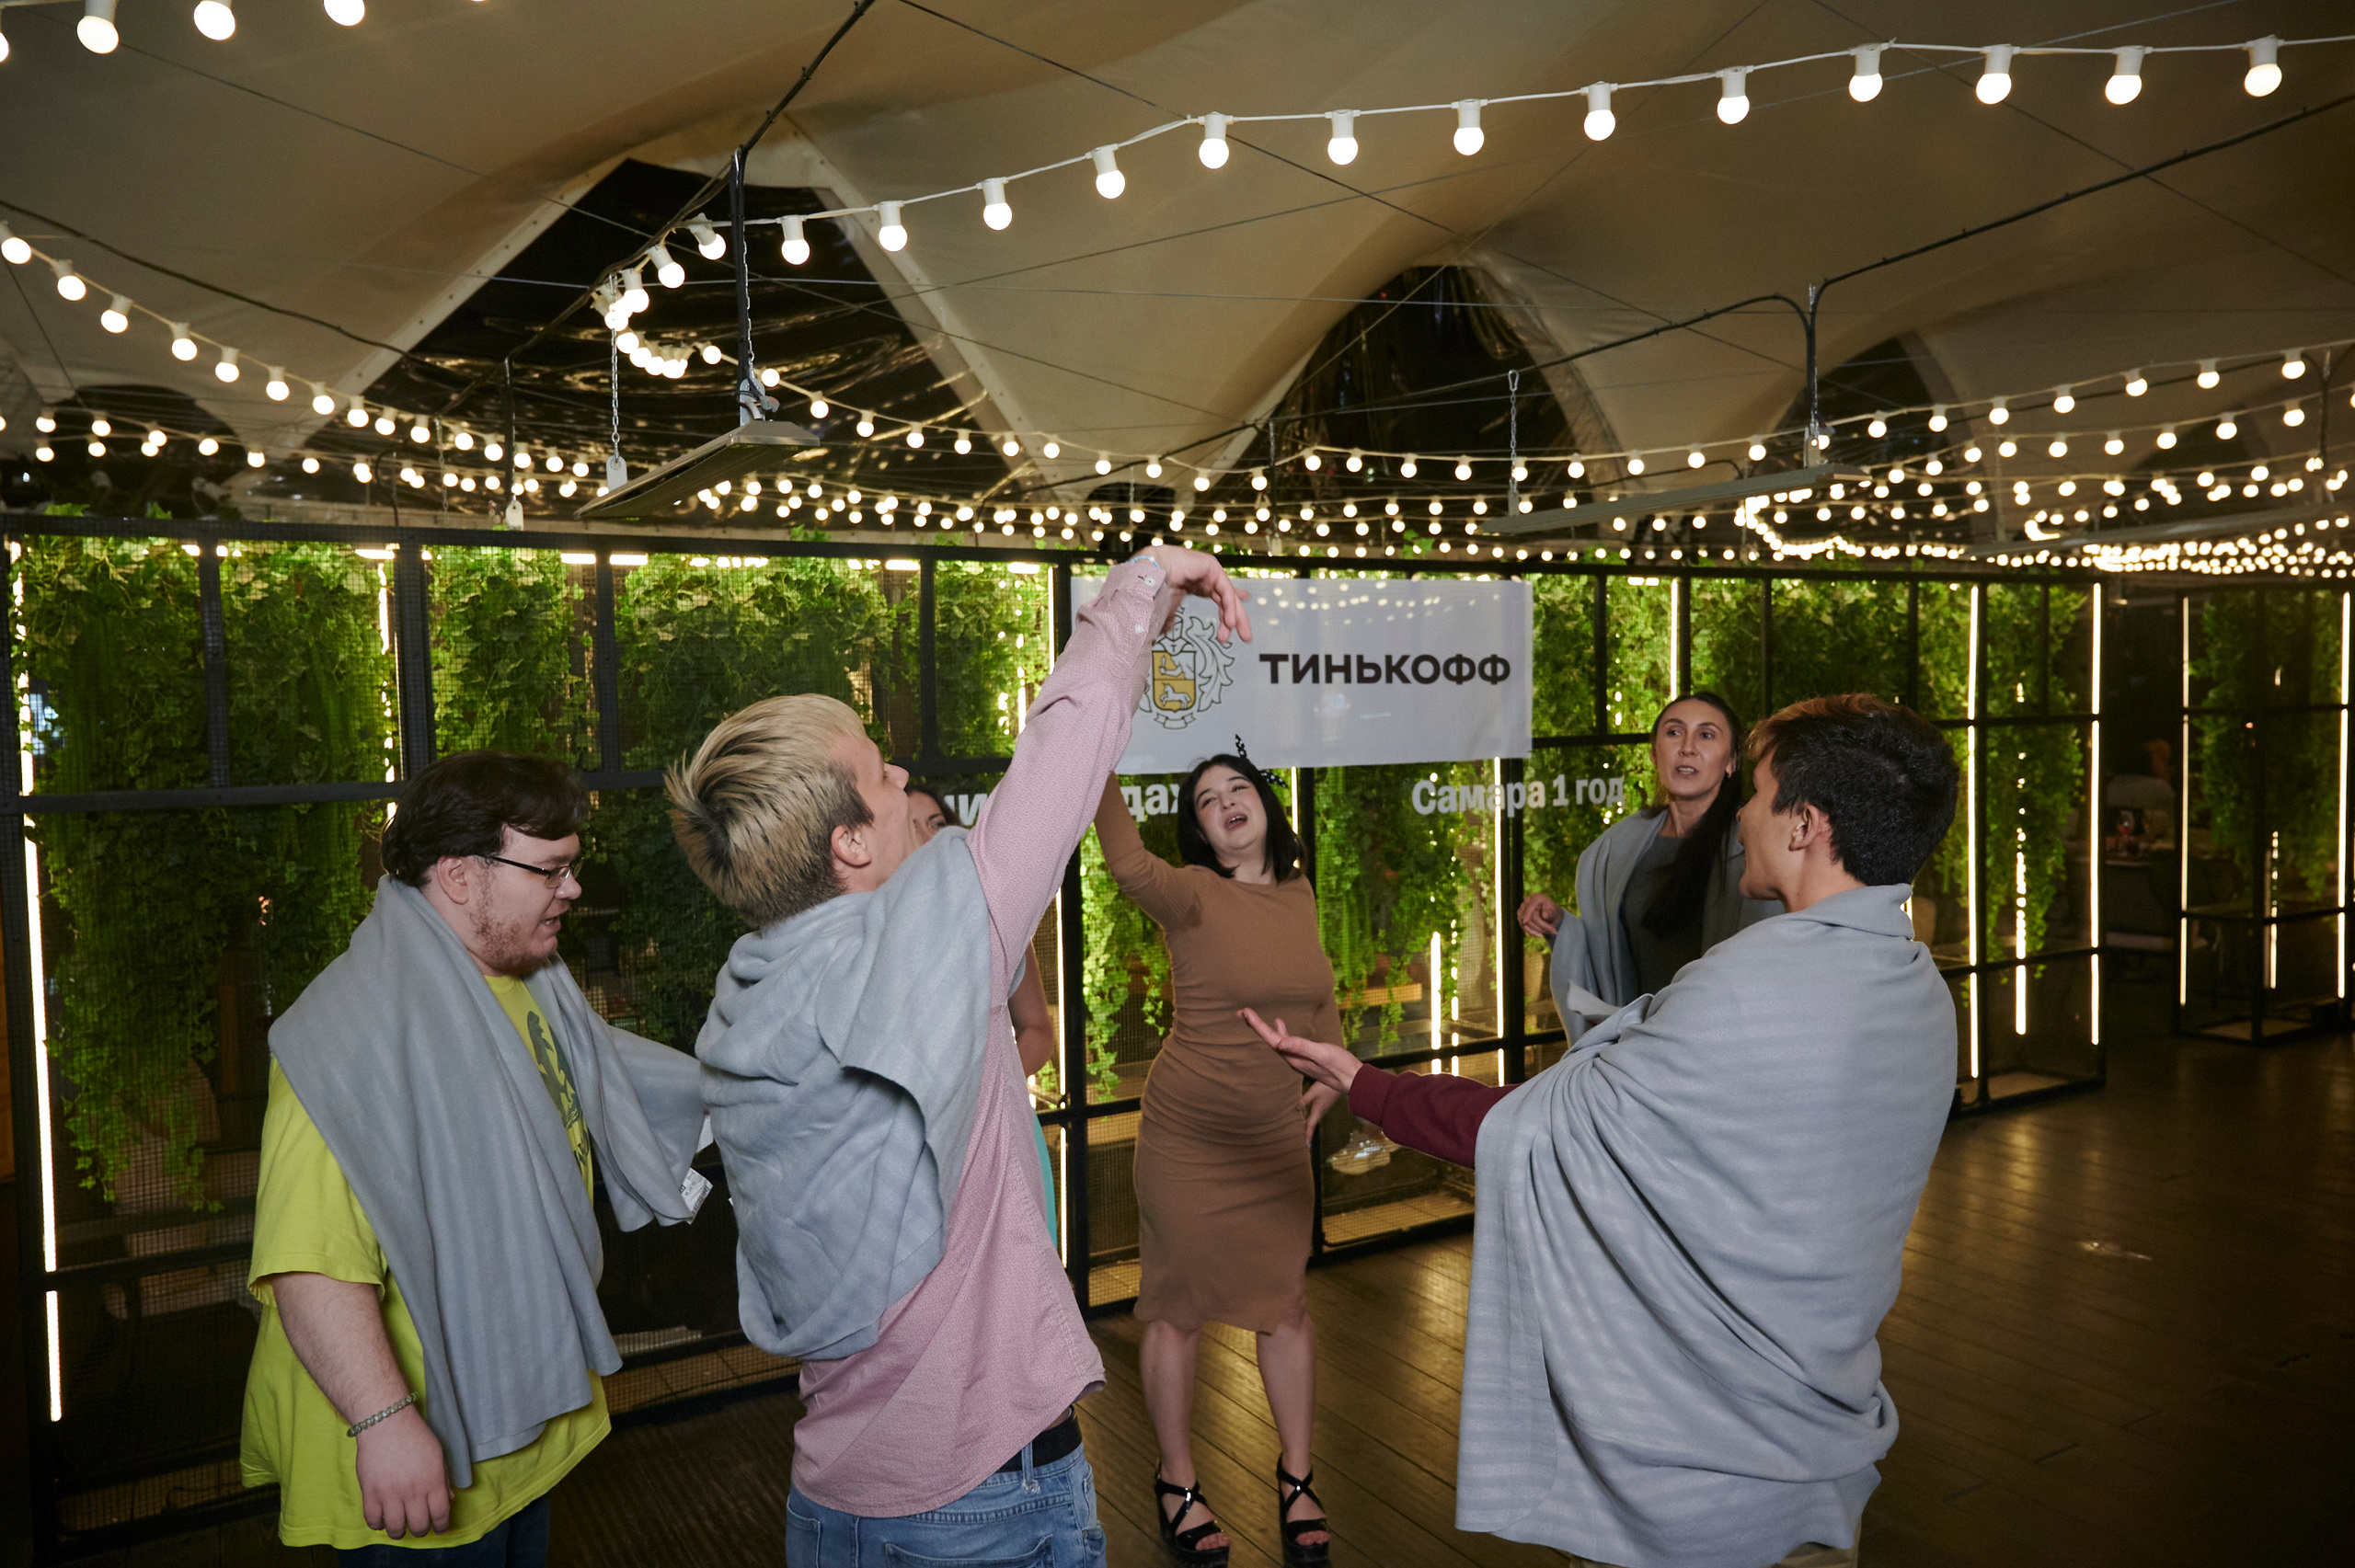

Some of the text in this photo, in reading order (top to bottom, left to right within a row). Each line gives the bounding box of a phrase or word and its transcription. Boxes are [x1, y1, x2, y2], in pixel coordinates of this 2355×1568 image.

[1259, 653, 1511, 685] ТИНЬКОФФ
[1412, 773, 1626, 818] Самара 1 год
